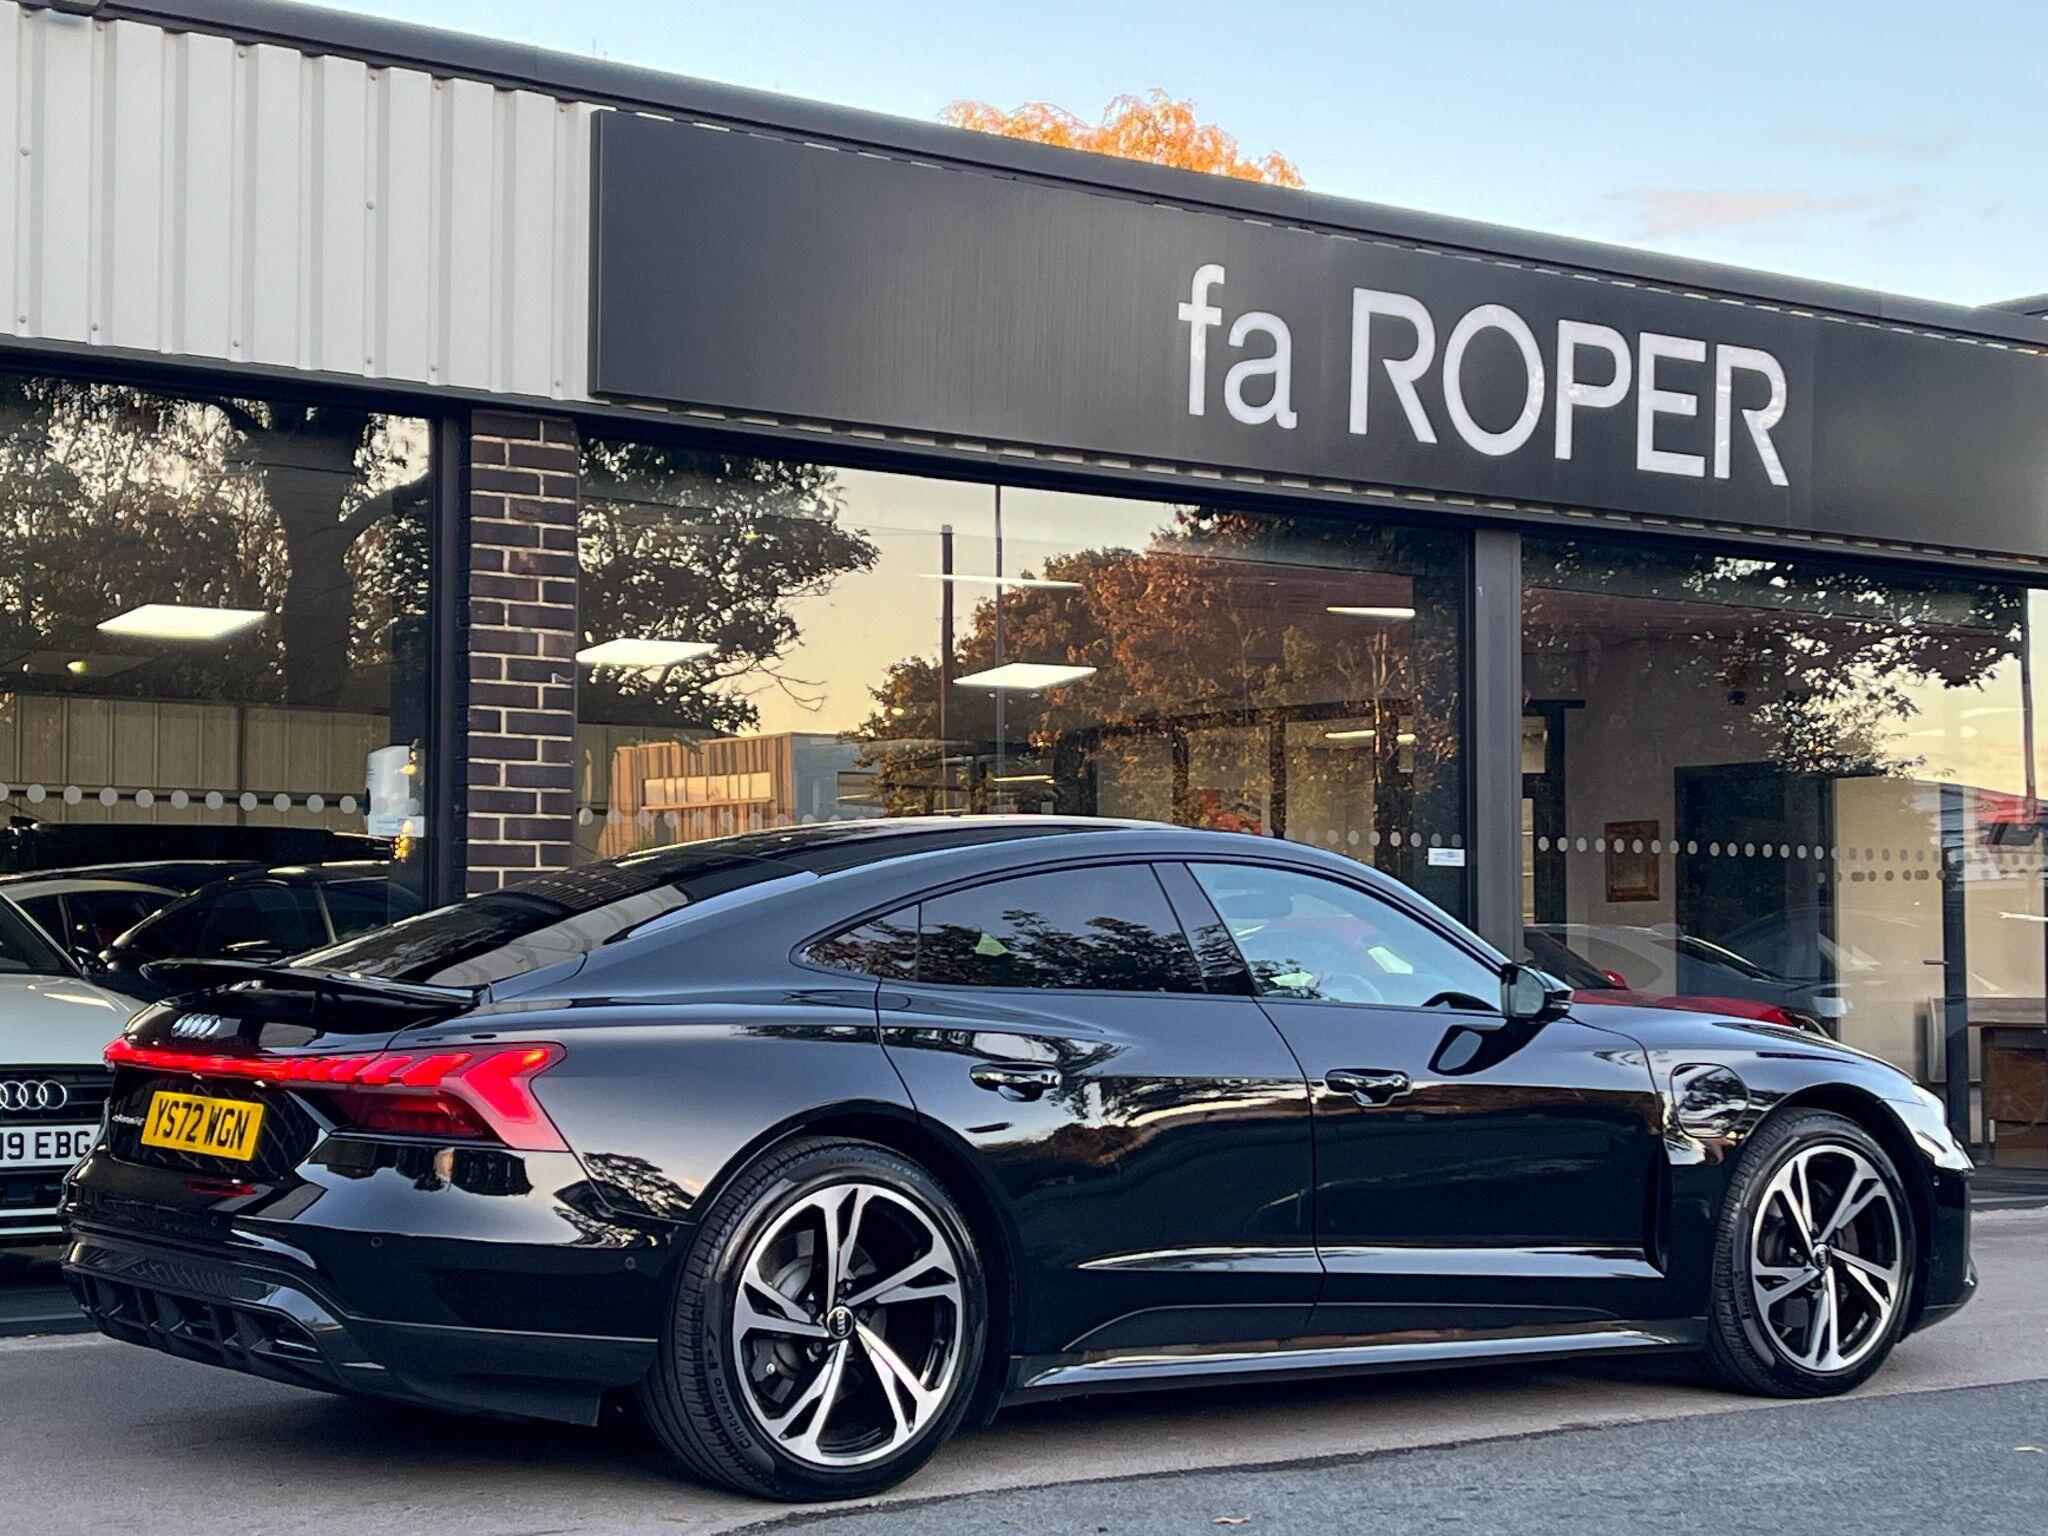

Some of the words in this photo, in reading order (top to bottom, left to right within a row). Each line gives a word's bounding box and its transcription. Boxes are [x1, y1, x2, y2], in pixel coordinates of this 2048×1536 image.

[1178, 263, 1297, 429] fa
[1349, 287, 1789, 486] ROPER
[35, 1131, 91, 1159] EBG
[153, 1098, 204, 1143] YS72
[204, 1105, 250, 1151] WGN
